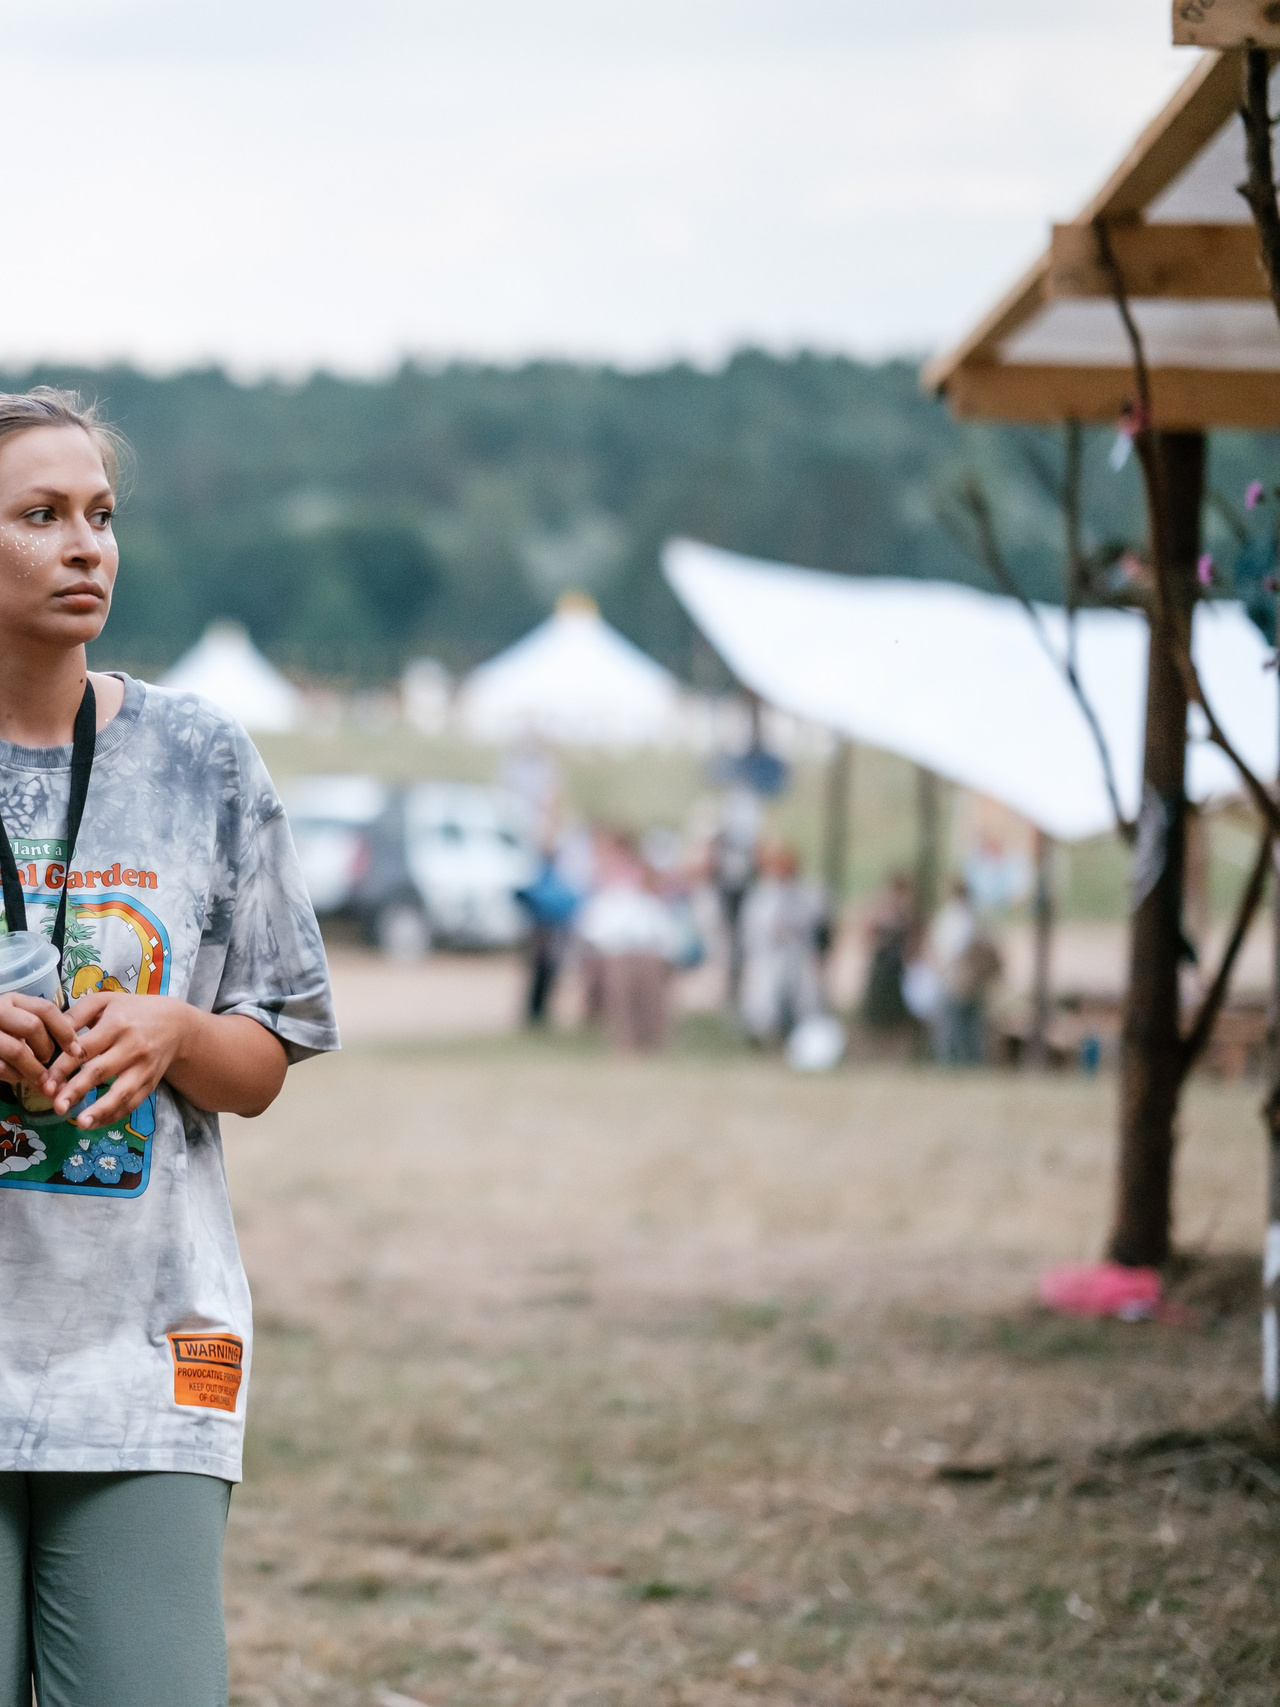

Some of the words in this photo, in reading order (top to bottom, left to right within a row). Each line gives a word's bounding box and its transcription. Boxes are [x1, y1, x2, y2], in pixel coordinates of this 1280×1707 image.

[9, 841, 51, 856] lant
[55, 845, 62, 856] a
[44, 862, 158, 889] Garden
[184, 1343, 239, 1362] WARNING
[177, 1367, 223, 1381] PROVOCATIVE
[189, 1382, 204, 1391] KEEP
[205, 1383, 218, 1393] OUT
[199, 1393, 208, 1402] OF
